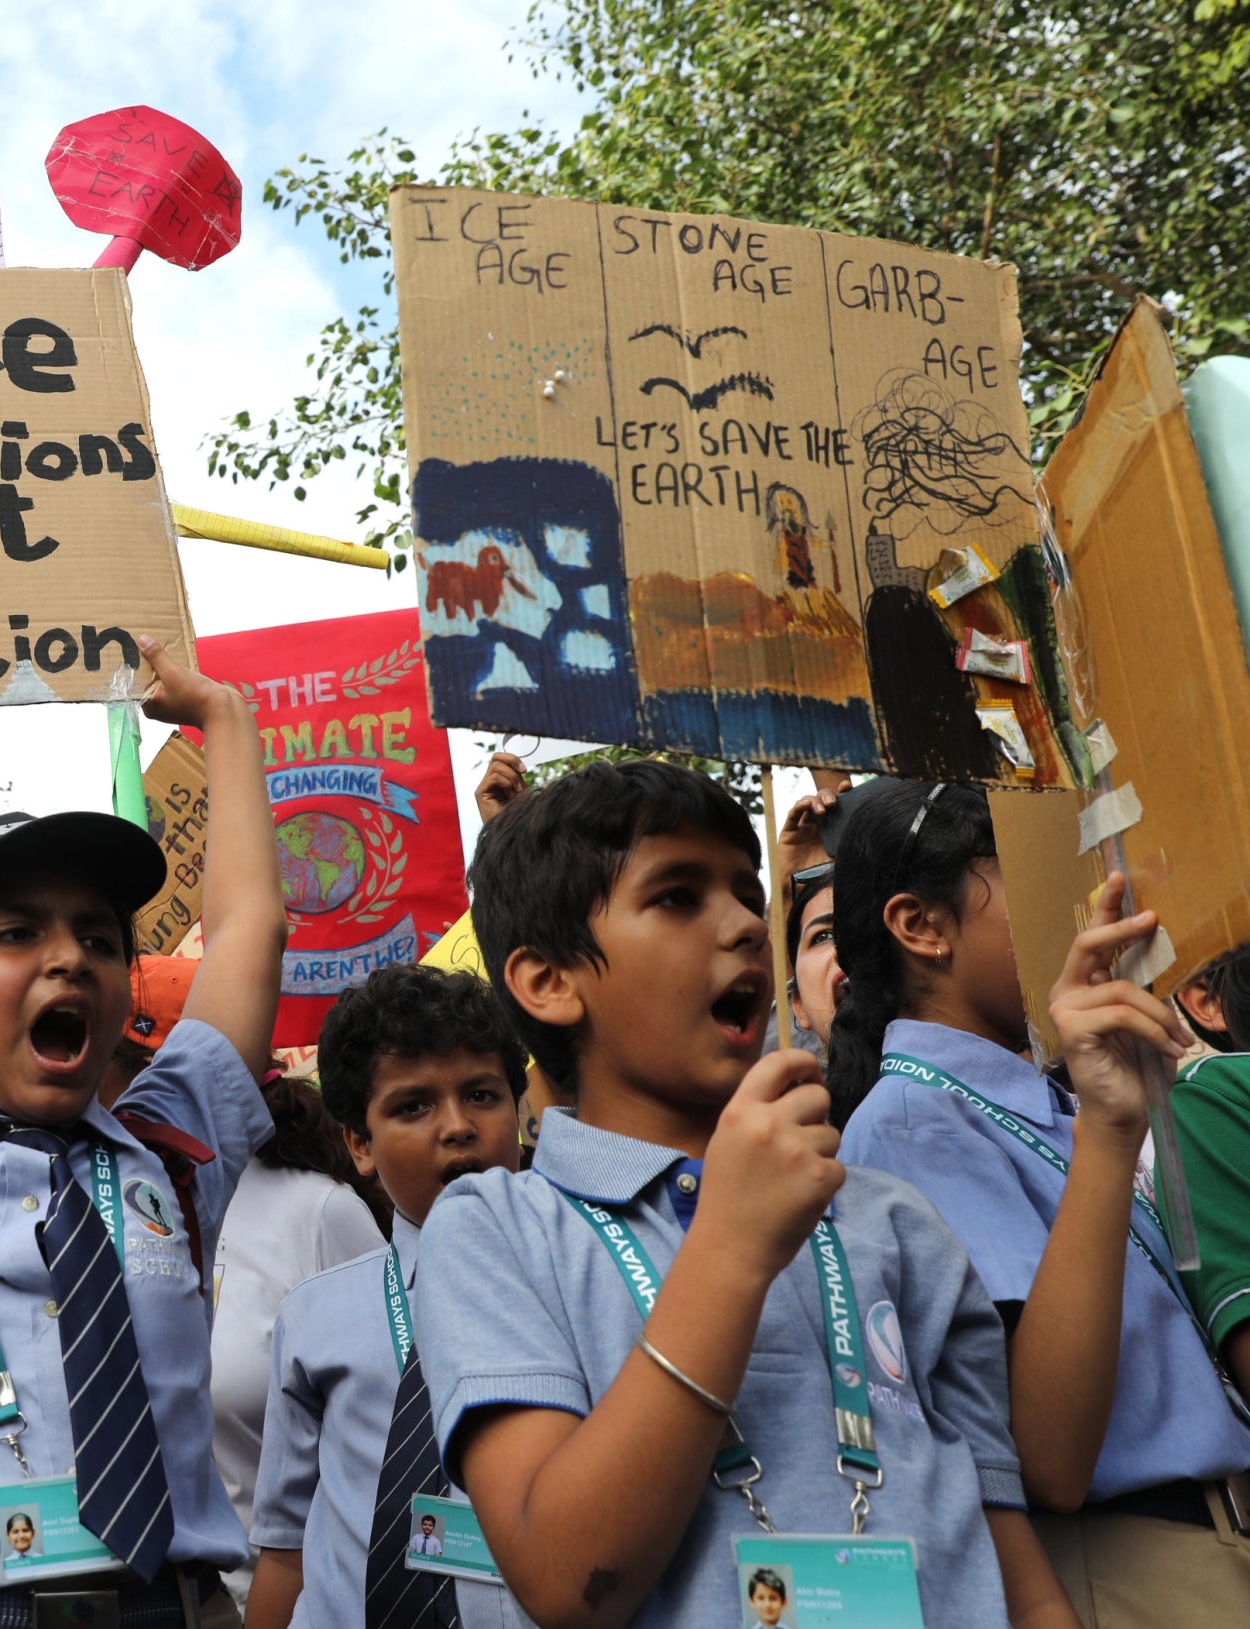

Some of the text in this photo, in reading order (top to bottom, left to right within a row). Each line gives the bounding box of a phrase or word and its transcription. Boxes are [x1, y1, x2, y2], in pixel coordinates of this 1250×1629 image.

[108, 123, 208, 178] SAVE
[89, 170, 190, 238] EARTH
[409, 198, 532, 244] ICE
[613, 215, 768, 262] STONE
[476, 242, 571, 295] AGE
[713, 258, 792, 303] AGE
[836, 259, 965, 325] GARB-
[923, 337, 999, 392] AGE
[596, 416, 681, 453] LET'S
[699, 419, 790, 460] SAVE
[800, 421, 855, 468] THE
[631, 462, 760, 516] EARTH
[256, 671, 338, 711] THE
[262, 708, 417, 767] IMATE
[270, 768, 378, 799] CHANGING
[165, 786, 209, 856] tha
[136, 895, 192, 955] ung
[293, 954, 372, 983] AREN'T
[374, 936, 415, 969] WE?
[603, 1223, 657, 1313] HWAYS
[814, 1220, 854, 1357] PATHWAYS
[391, 1295, 411, 1365] THWAYS
